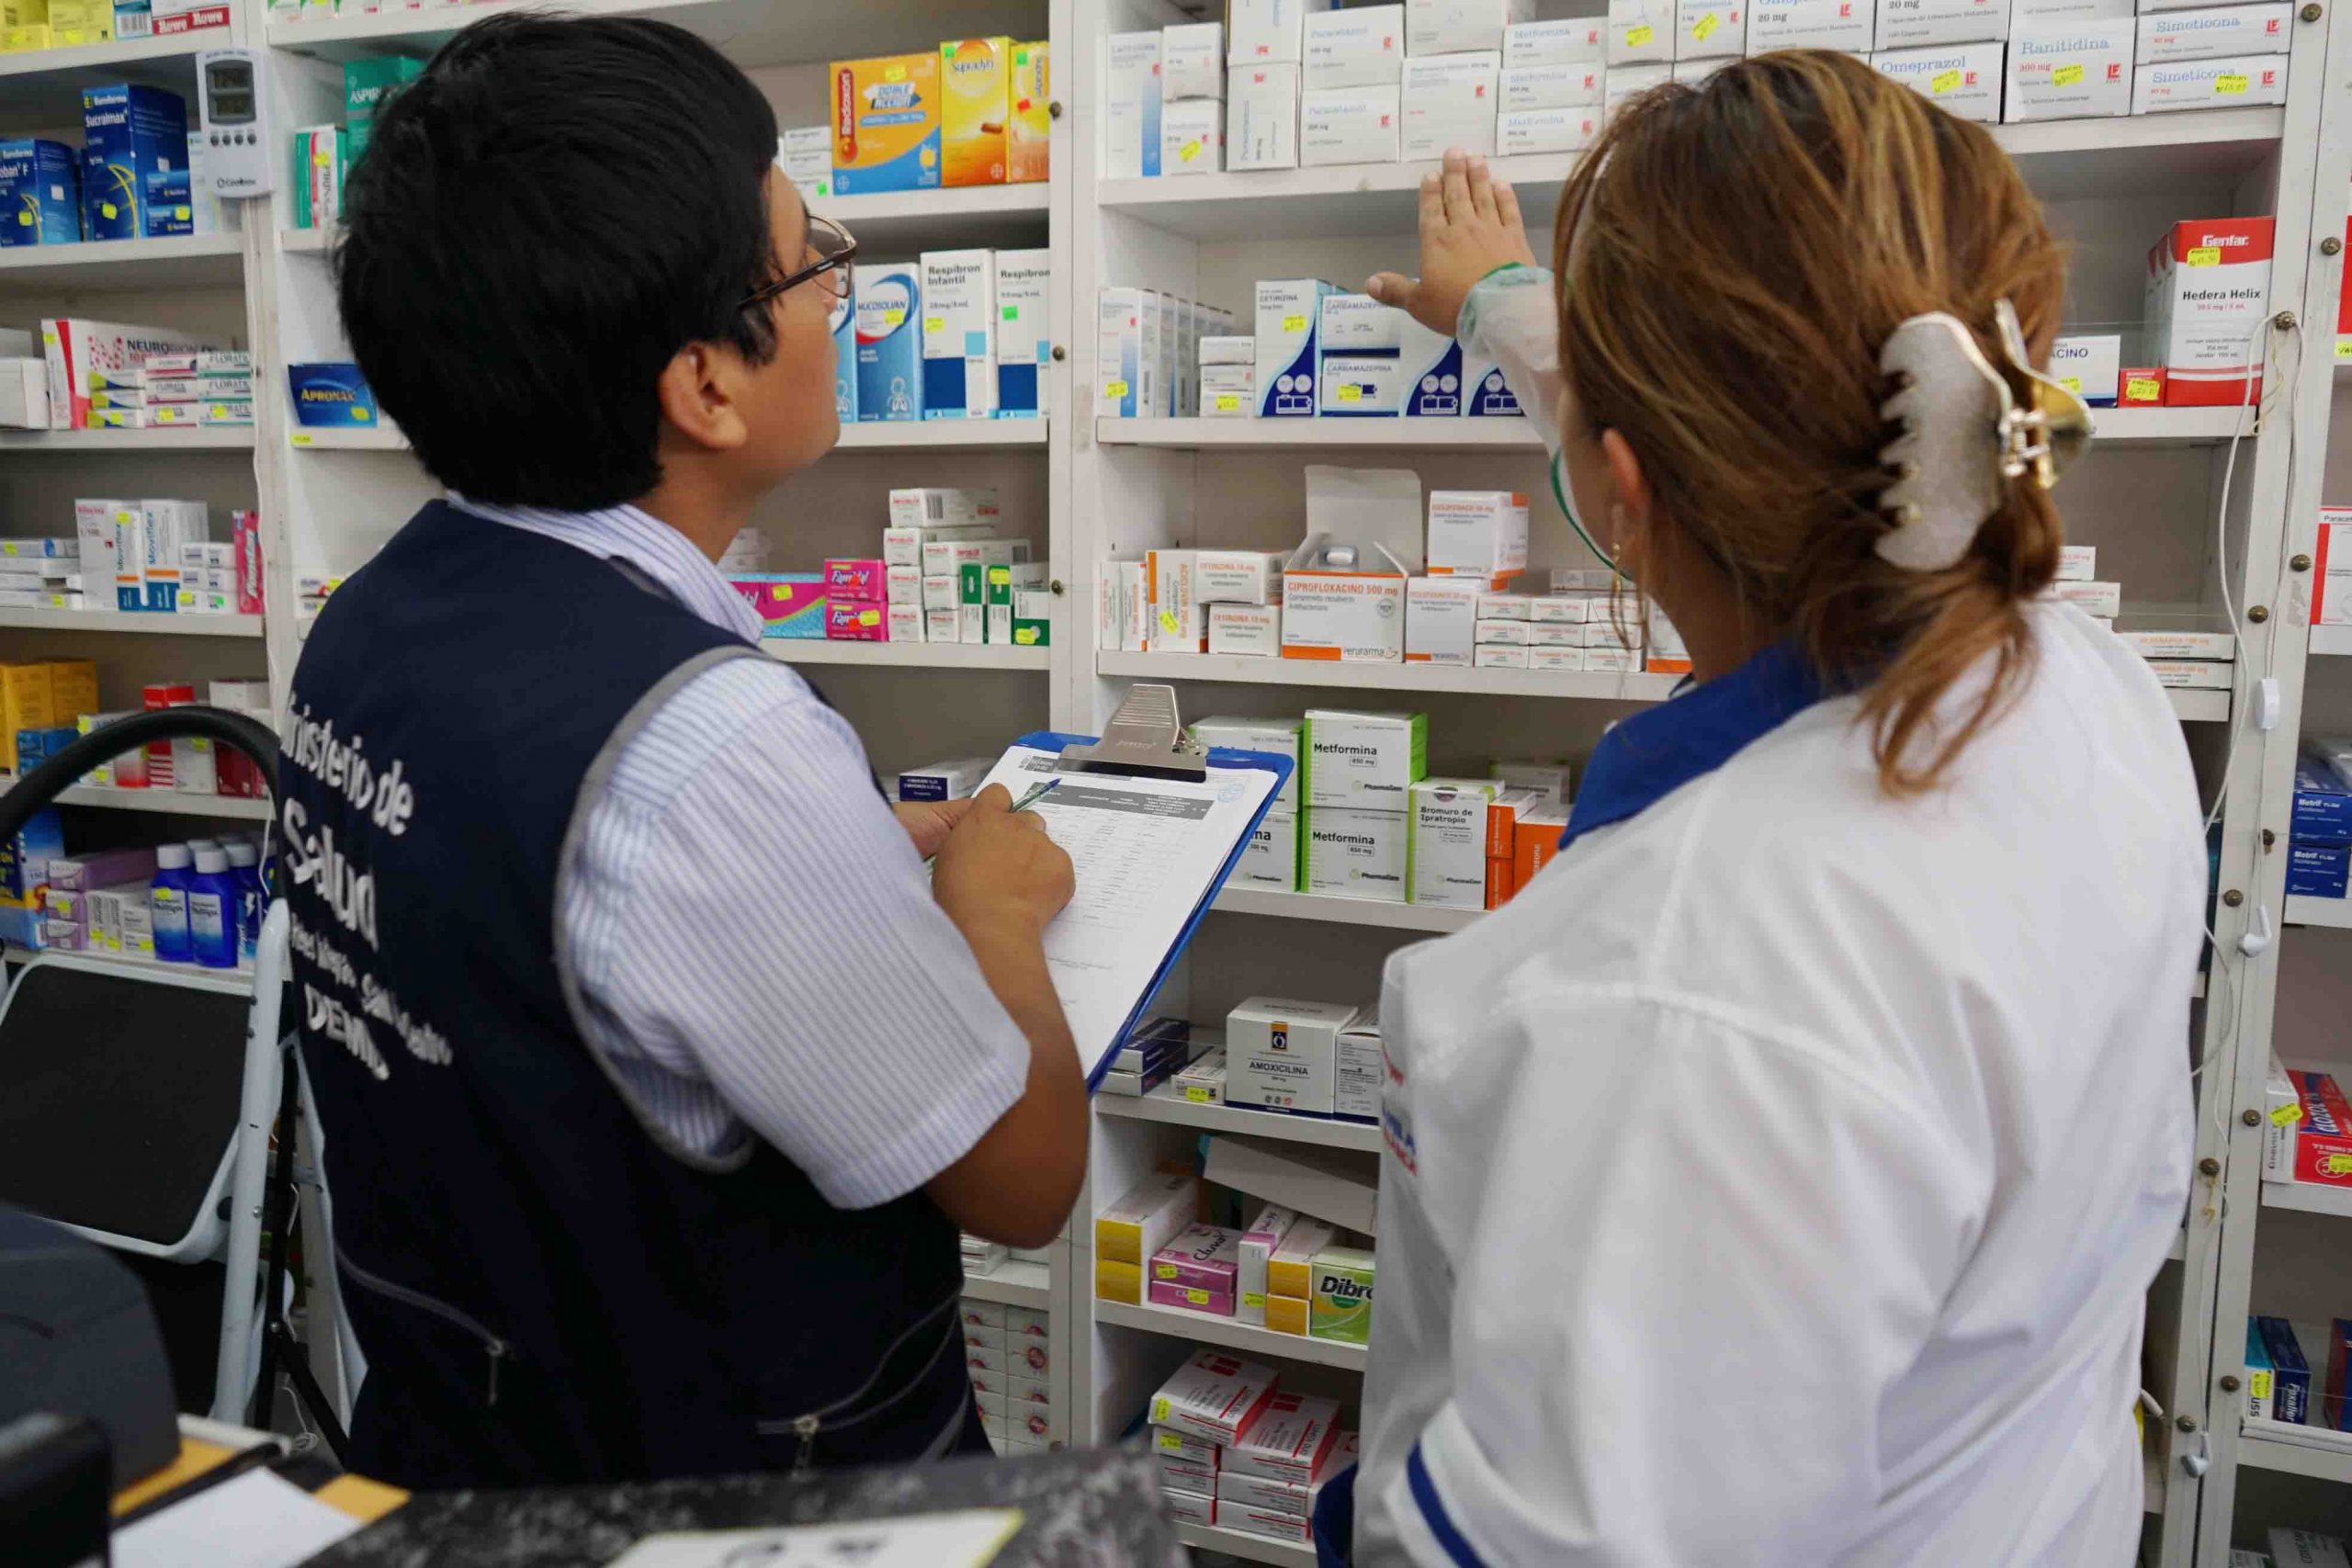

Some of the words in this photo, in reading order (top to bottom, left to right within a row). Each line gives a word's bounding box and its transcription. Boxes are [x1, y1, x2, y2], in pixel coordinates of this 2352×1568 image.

[1771, 13, 1788, 24] mg
[2156, 17, 2241, 34] Simeticona
[2021, 38, 2110, 55] Ranitidina
[1881, 56, 1966, 74] Omeprazol
[2202, 234, 2247, 247] Genfar
[928, 263, 981, 278] Respibron
[1000, 268, 1051, 280] Respibron
[927, 276, 966, 286] Infantil
[2183, 290, 2226, 301] Hedera
[2230, 288, 2261, 299] Helix
[857, 300, 907, 311] MUCOSOLVAN
[300, 388, 356, 403] APRONAX
[1287, 581, 1363, 593] CIPROFLOXACINO
[1366, 584, 1383, 594] 500
[1385, 587, 1397, 596] mg
[1314, 743, 1378, 756] Metformina
[1363, 783, 1403, 792] PharmaGen
[372, 758, 413, 836] de
[1420, 807, 1460, 816] Bromuro
[1462, 807, 1473, 816] de
[1420, 815, 1466, 824] Ipratropio
[1312, 830, 1375, 845] Metformina
[1363, 847, 1373, 855] mg
[1250, 1061, 1309, 1076] AMOXICILINA
